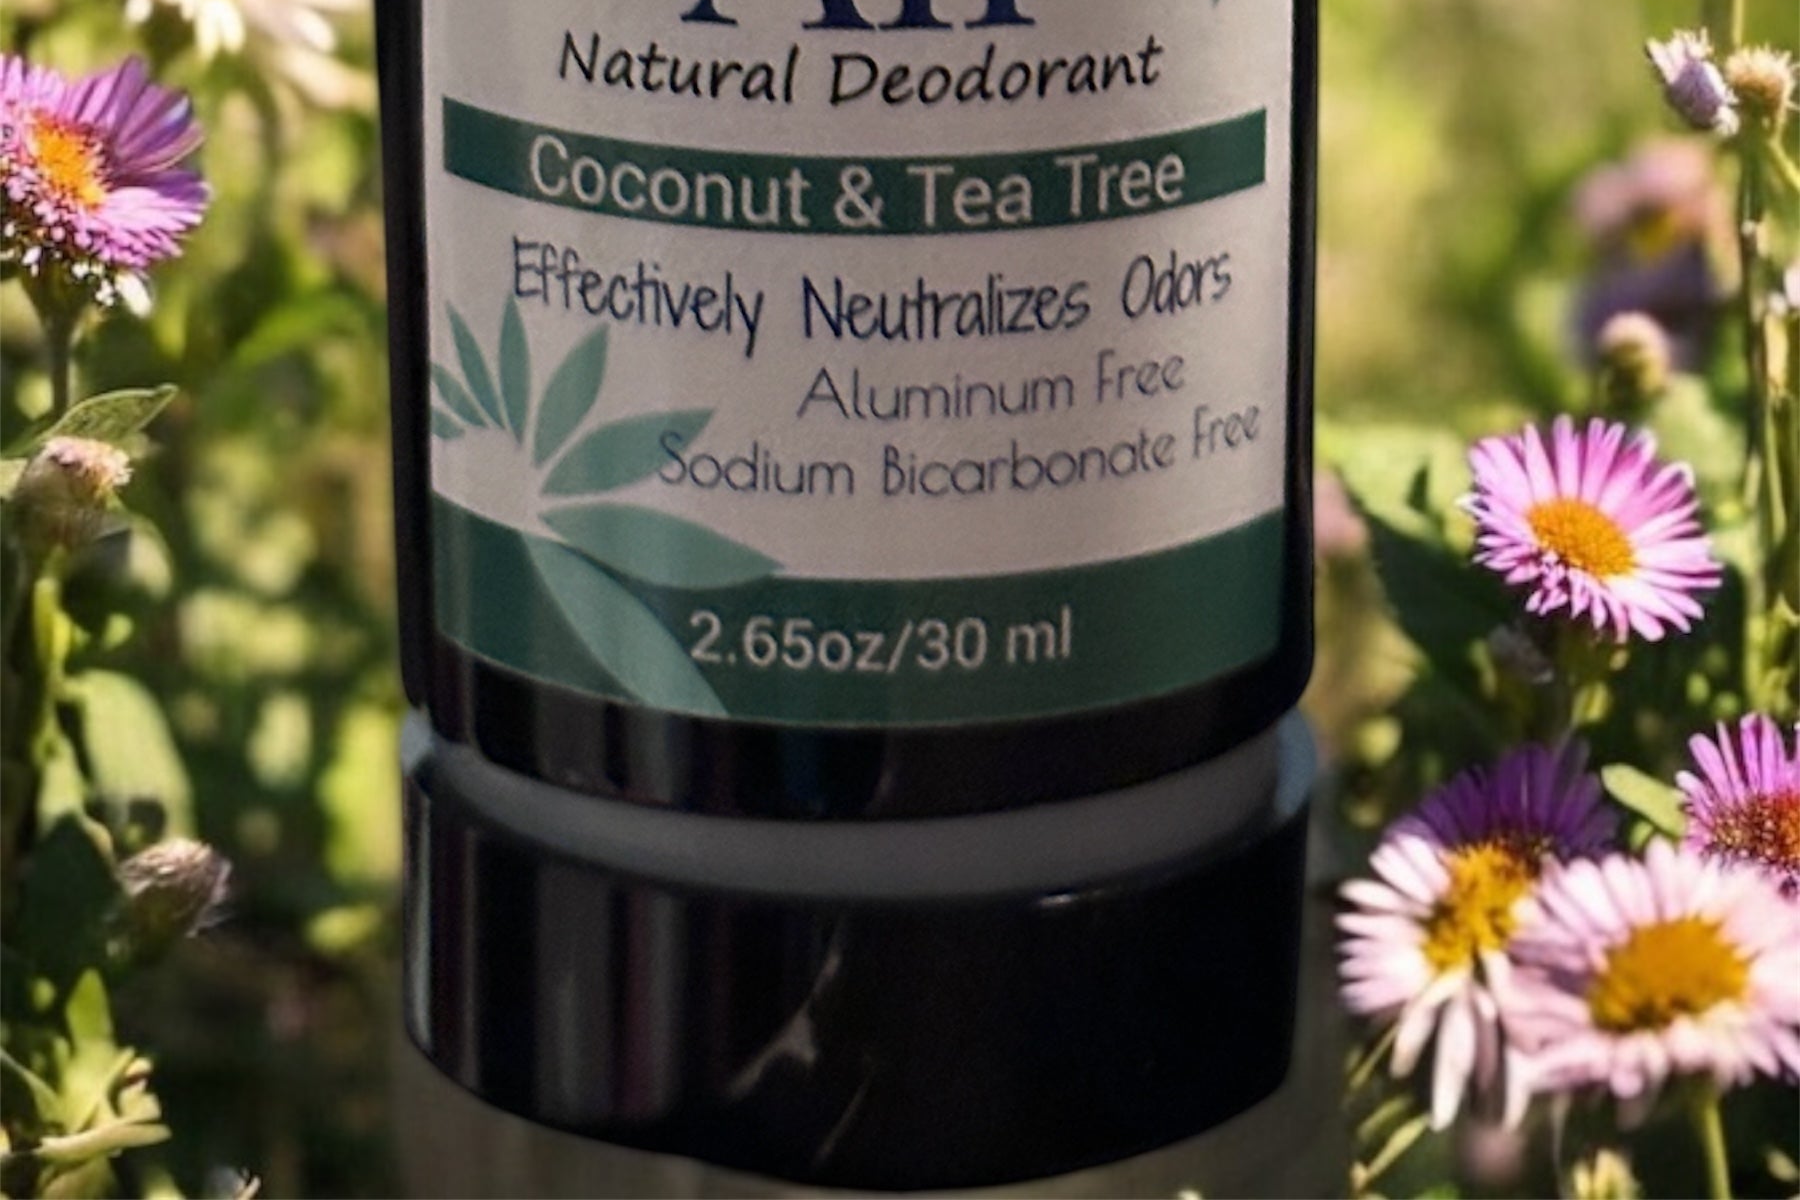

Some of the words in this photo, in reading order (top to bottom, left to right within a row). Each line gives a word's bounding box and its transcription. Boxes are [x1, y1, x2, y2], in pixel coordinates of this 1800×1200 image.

[558, 30, 798, 105] Natural
[828, 35, 1164, 106] Deodorant
[529, 134, 811, 225] Coconut
[833, 168, 883, 228] &
[907, 164, 1034, 227] Tea
[1054, 150, 1186, 215] Tree
[512, 234, 764, 357] Effectively
[802, 273, 1091, 341] Neutralizes
[1121, 247, 1232, 321] Odors
[797, 367, 1075, 421] Aluminum
[1096, 347, 1186, 401] Free
[657, 431, 854, 496] Sodium
[882, 429, 1176, 497] Bicarbonate
[1192, 404, 1262, 460] Free
[688, 610, 988, 675] 2.65oz/30
[1005, 606, 1073, 663] ml
